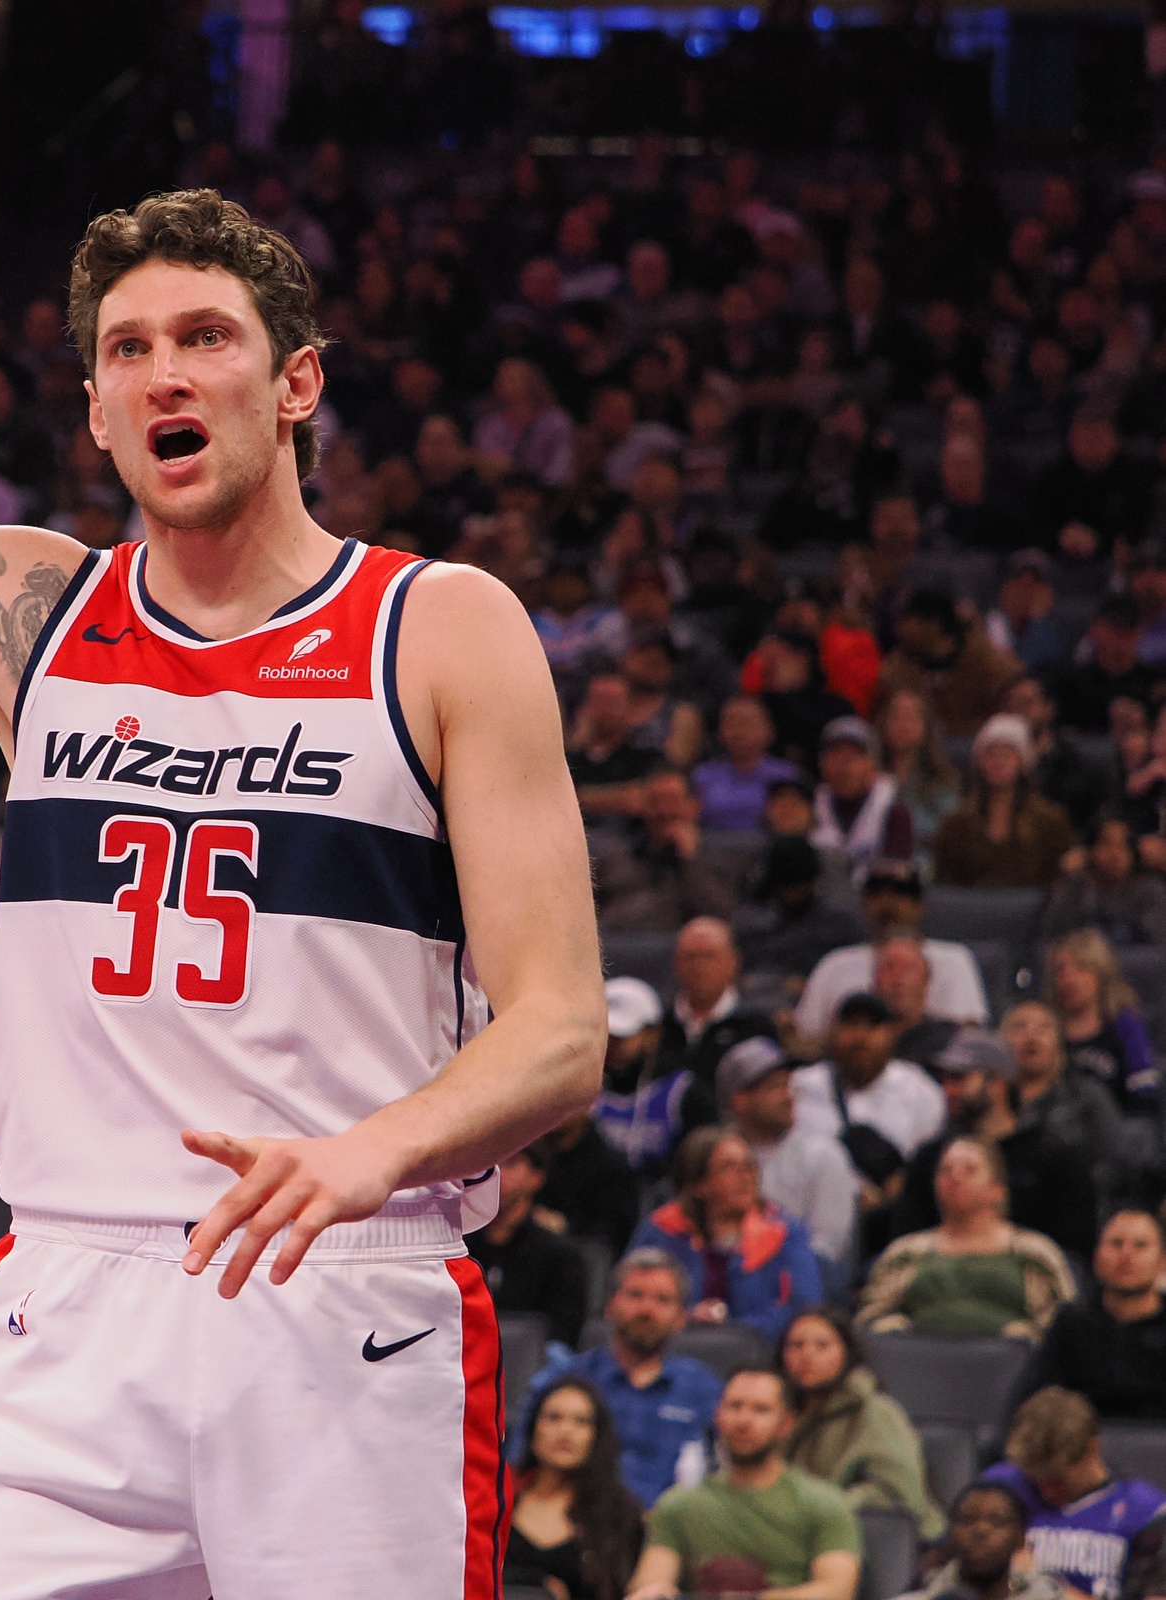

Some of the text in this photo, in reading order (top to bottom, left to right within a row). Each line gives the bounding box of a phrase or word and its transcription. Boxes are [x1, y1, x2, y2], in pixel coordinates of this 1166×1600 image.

[258, 665, 349, 680] Robinhood
[44, 716, 355, 797] wizards
[90, 816, 258, 1009] 35
